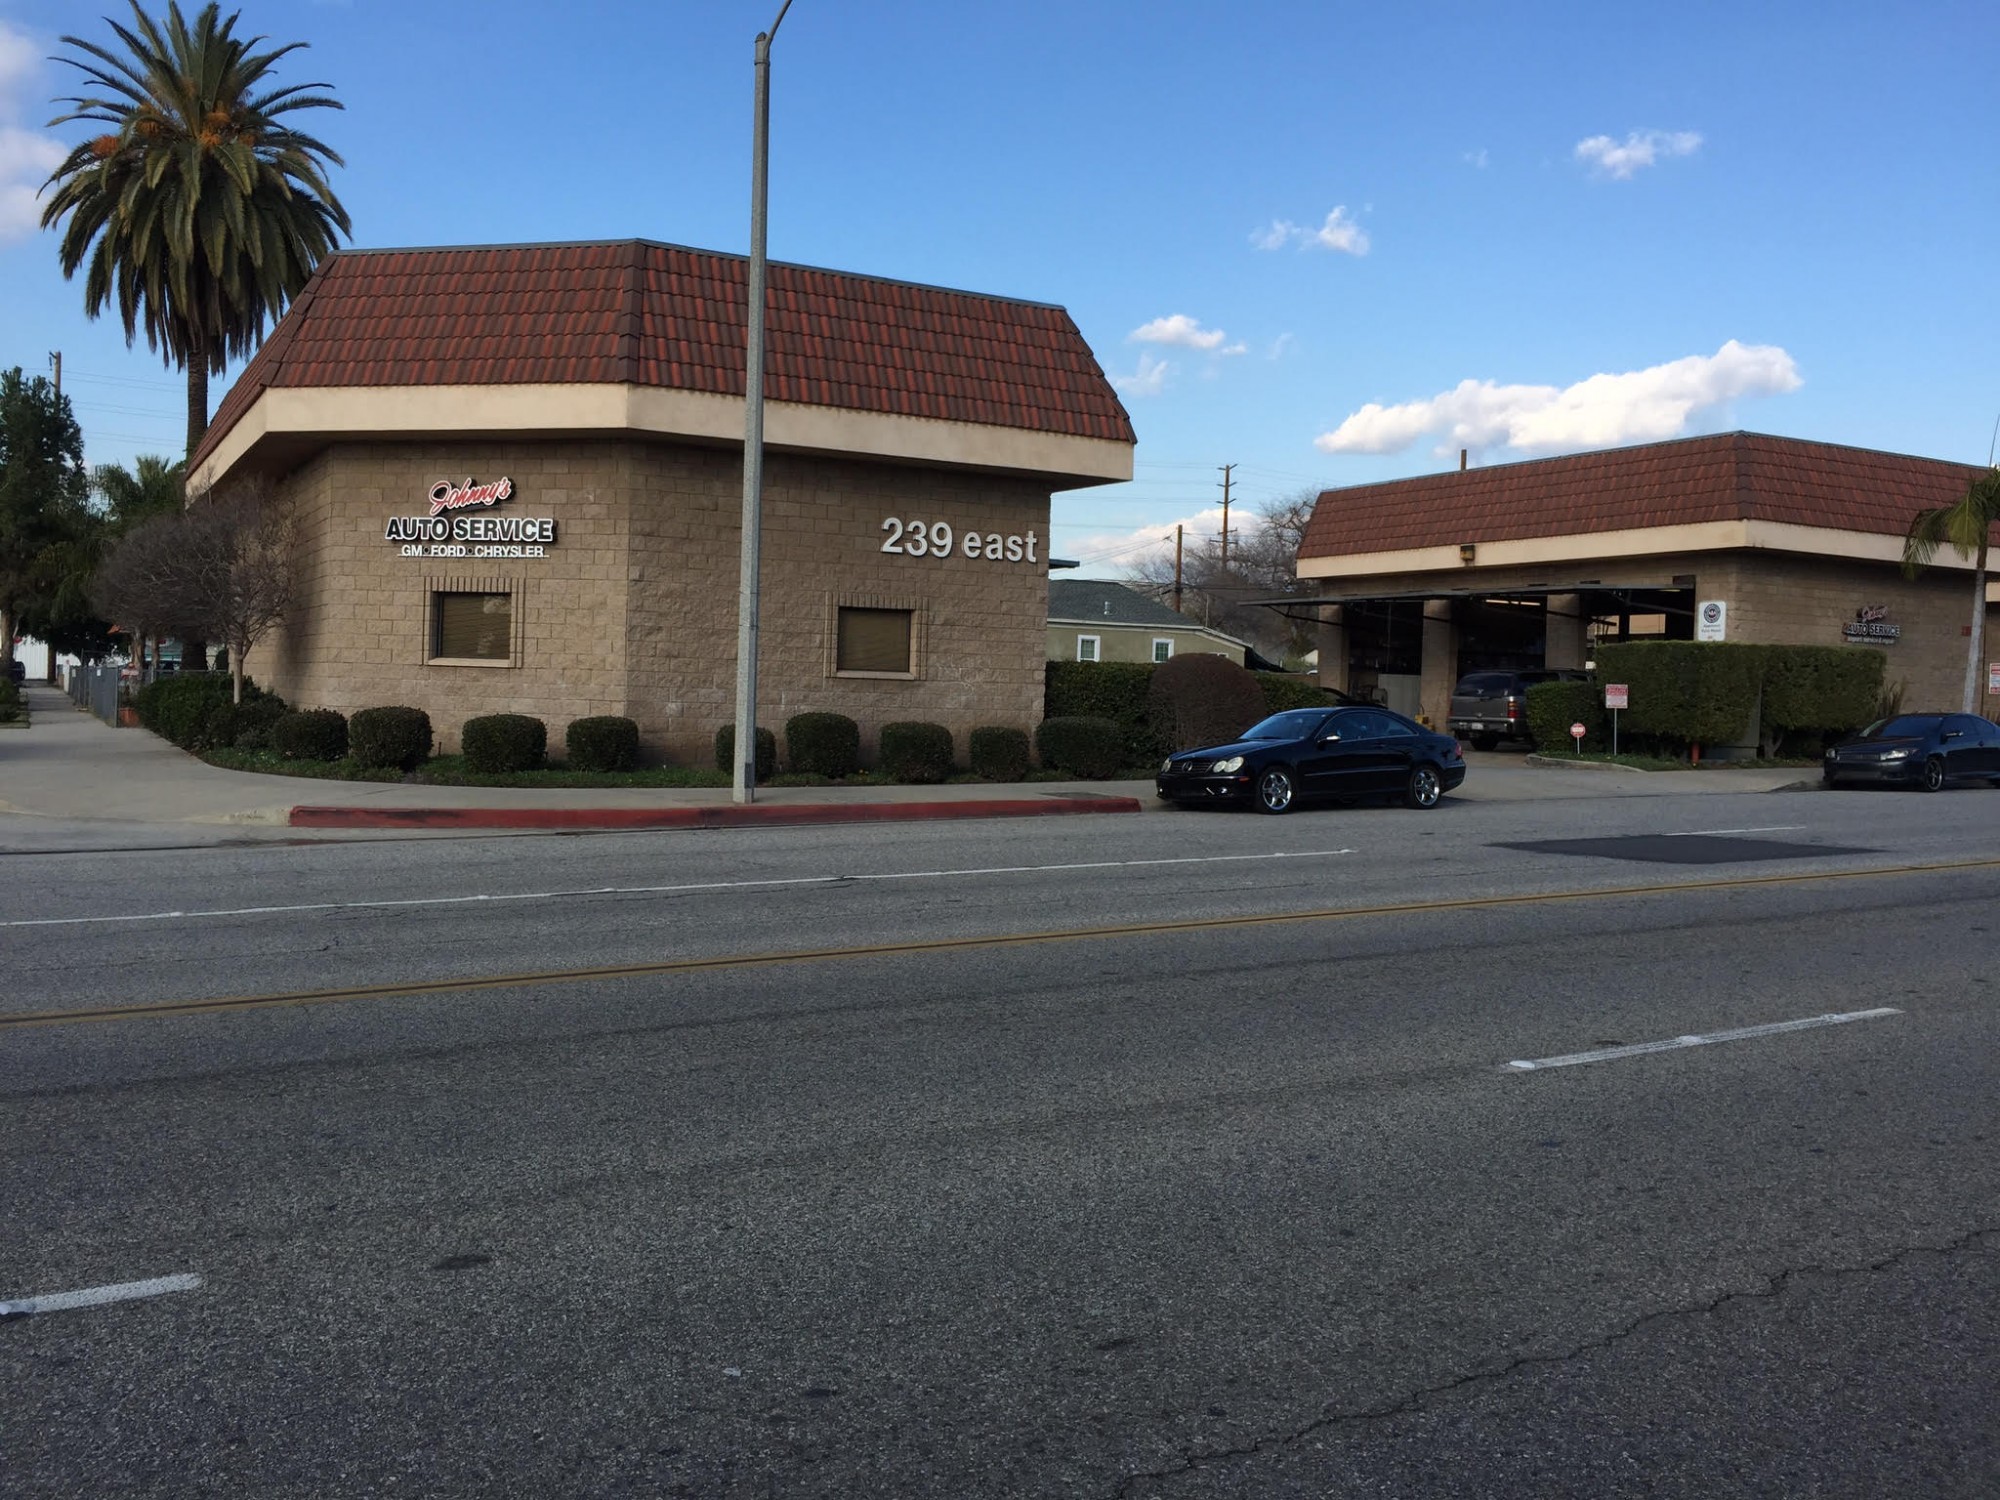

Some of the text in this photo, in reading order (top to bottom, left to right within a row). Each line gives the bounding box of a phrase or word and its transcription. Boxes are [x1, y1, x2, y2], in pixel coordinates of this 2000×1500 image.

[429, 476, 512, 516] Johnny's
[385, 516, 553, 542] AUTO SERVICE
[881, 517, 1037, 563] 239 east
[402, 544, 544, 558] GM FORD CHRYSLER
[1847, 622, 1900, 638] AUTO SERVICE
